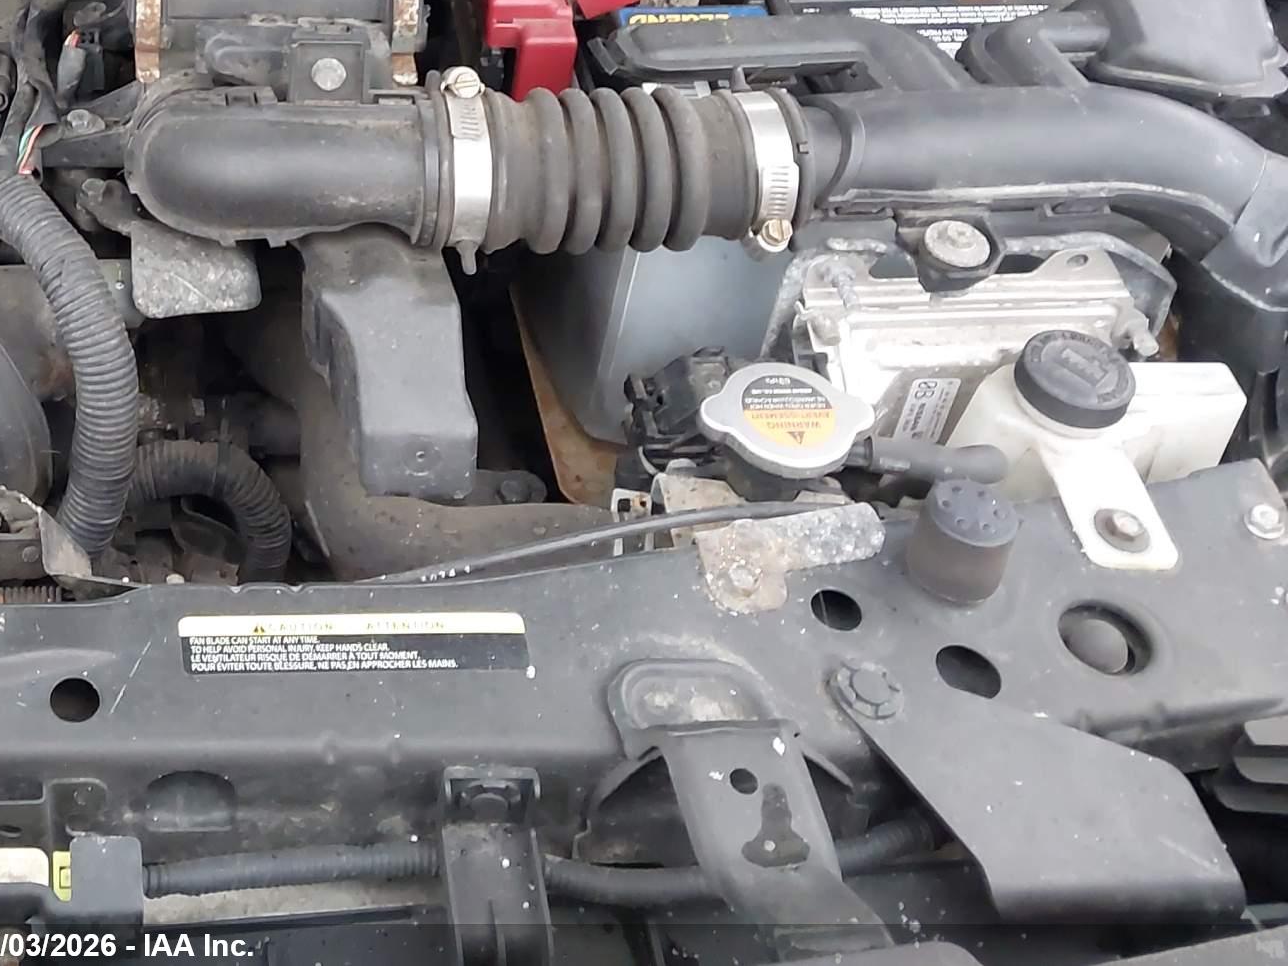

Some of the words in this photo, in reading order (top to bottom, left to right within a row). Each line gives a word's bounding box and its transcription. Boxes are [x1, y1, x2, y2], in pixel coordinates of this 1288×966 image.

[766, 421, 821, 429] WARNING
[367, 621, 444, 630] ATTENTION
[190, 637, 205, 645] FAN
[206, 637, 230, 645] BLADE
[231, 636, 248, 645] CAN
[249, 636, 271, 644] START
[272, 636, 282, 644] AT
[282, 636, 299, 644] ANY
[300, 636, 320, 644] TIME.
[191, 645, 202, 654] TO
[203, 645, 222, 653] HELP
[223, 645, 247, 653] AVOID
[247, 644, 287, 653] PERSONAL
[316, 643, 335, 652] KEEP
[336, 642, 362, 652] HANDS
[364, 642, 390, 652] CLEAR.
[191, 654, 201, 663] LE
[202, 653, 257, 663] VENTILATEUR
[257, 653, 288, 662] RISQUE
[288, 653, 301, 662] DE
[355, 651, 378, 660] TOUT
[379, 650, 421, 660] MOMENT.
[191, 662, 216, 672] POUR
[245, 662, 273, 671] TOUTE
[273, 661, 317, 671] BLESSURE,
[317, 661, 330, 670] NE
[330, 661, 347, 670] PAS
[347, 660, 360, 670] EN
[360, 659, 412, 669] APPROCHER
[413, 659, 427, 669] LES
[428, 659, 459, 669] MAINS.
